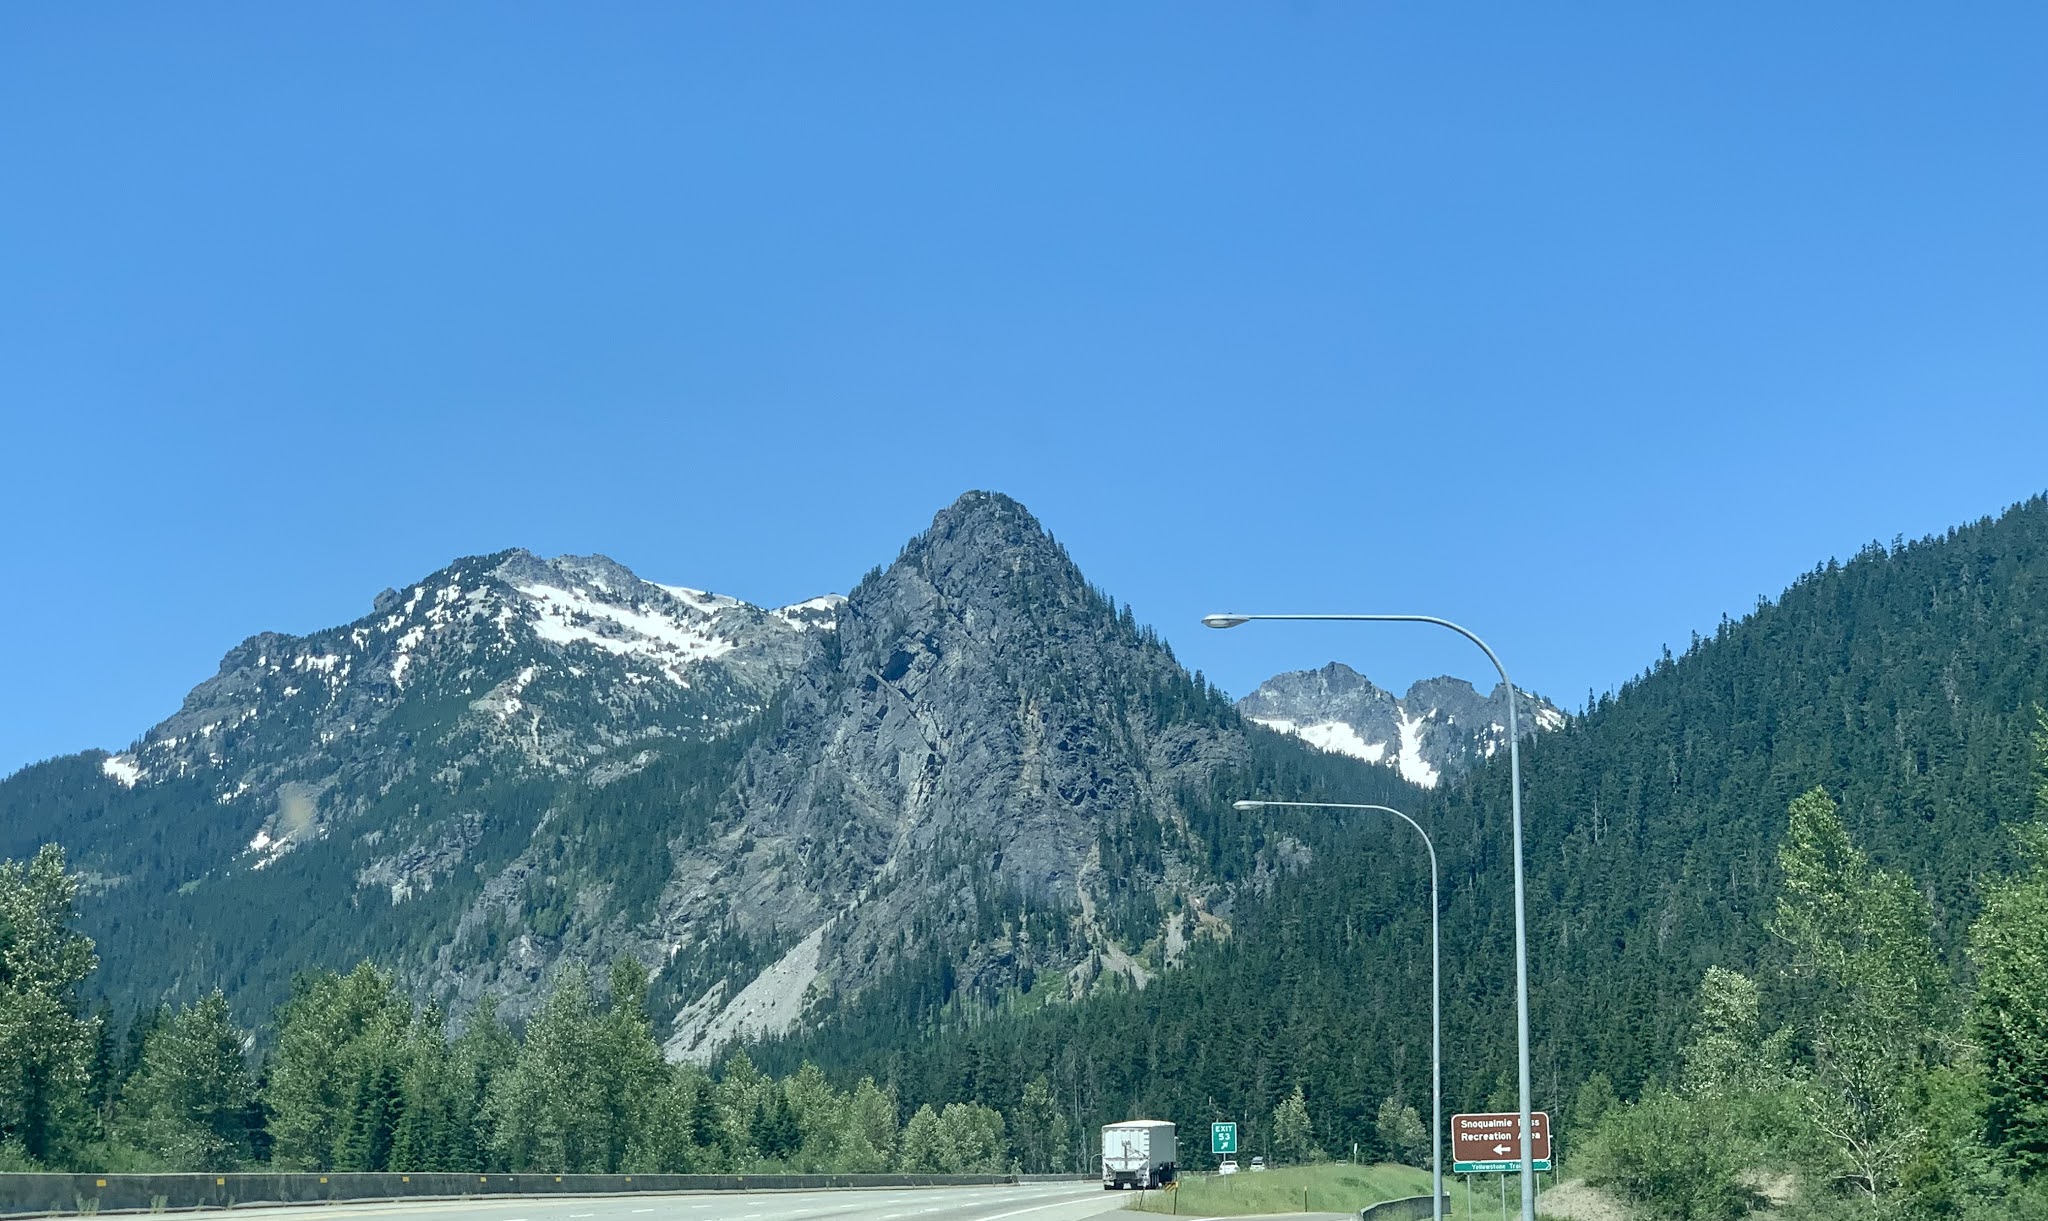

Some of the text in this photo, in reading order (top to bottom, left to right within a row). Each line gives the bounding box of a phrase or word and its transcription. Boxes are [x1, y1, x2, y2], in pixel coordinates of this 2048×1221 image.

[1461, 1119, 1512, 1129] Snoqualmie
[1461, 1132, 1540, 1141] Recreation ea
